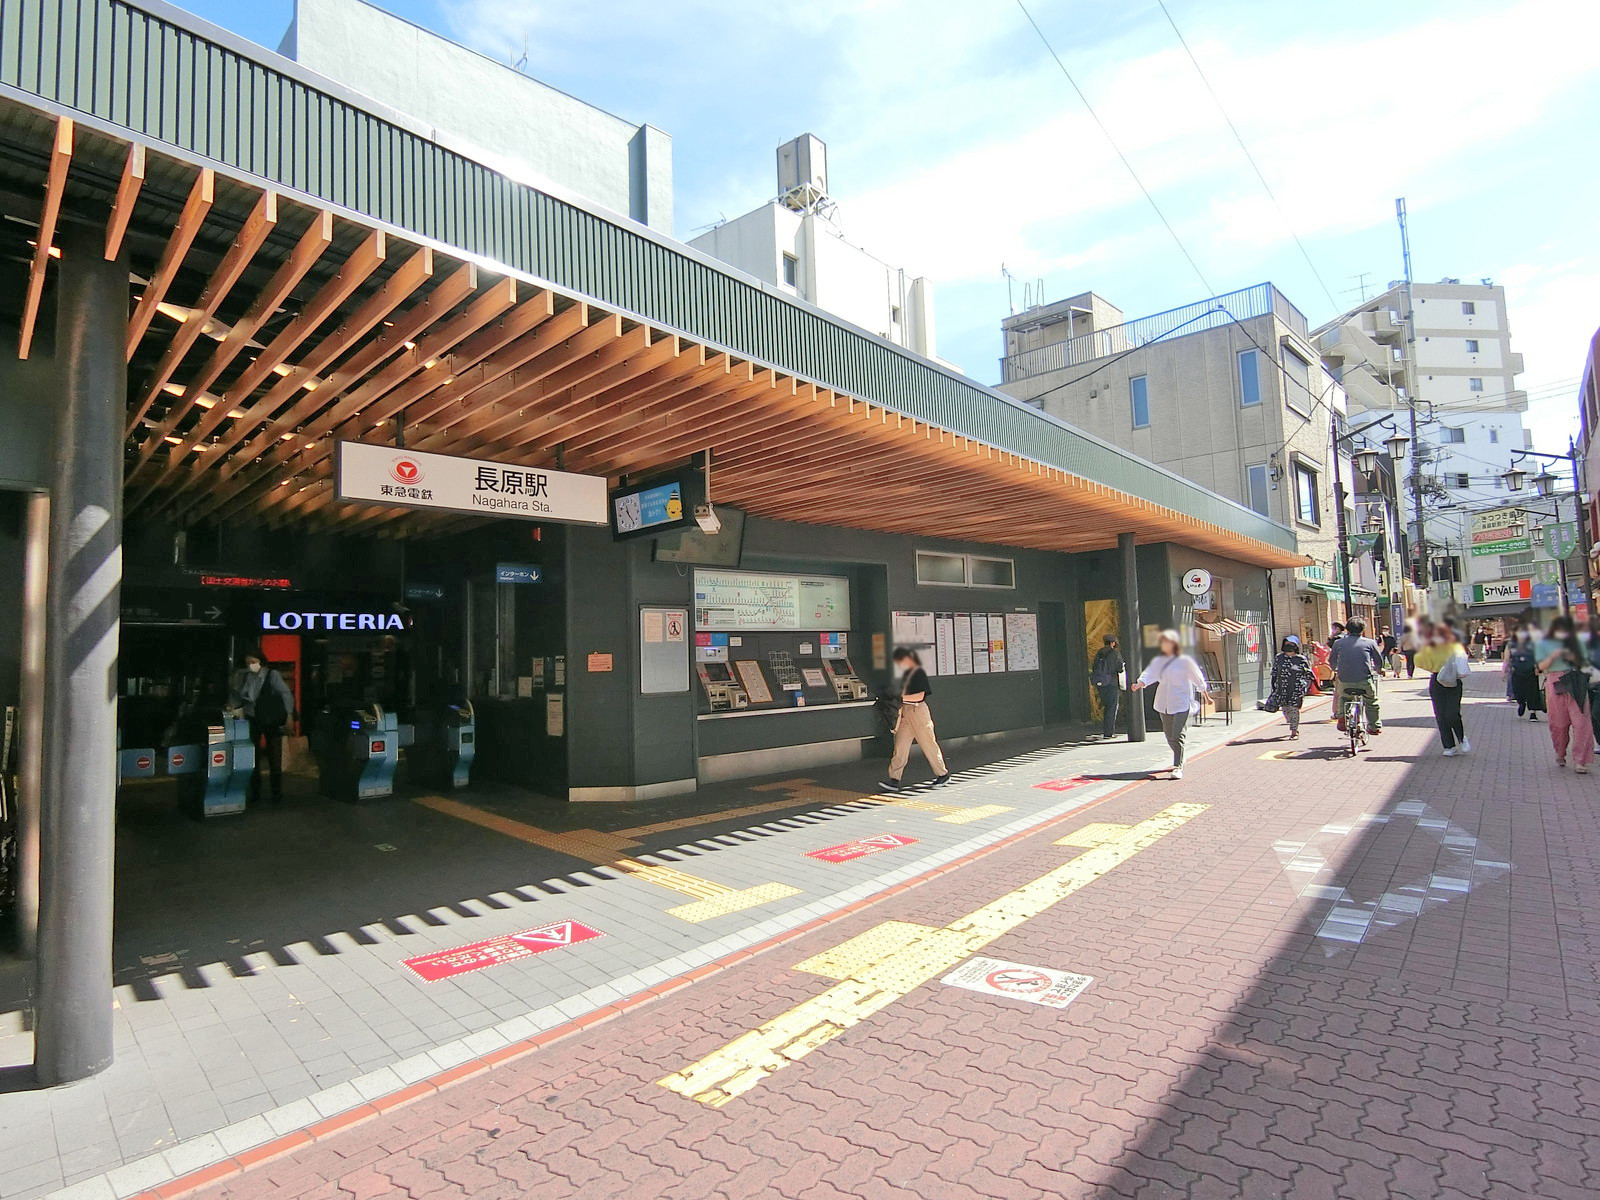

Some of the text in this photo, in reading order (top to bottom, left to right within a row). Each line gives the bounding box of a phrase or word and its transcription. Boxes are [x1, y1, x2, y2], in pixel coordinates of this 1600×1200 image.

[474, 466, 548, 498] 長原駅
[380, 484, 433, 501] 東急電鉄
[472, 494, 553, 513] Nagahara Sta.
[1484, 585, 1519, 596] STIVALE
[262, 612, 404, 630] LOTTERIA
